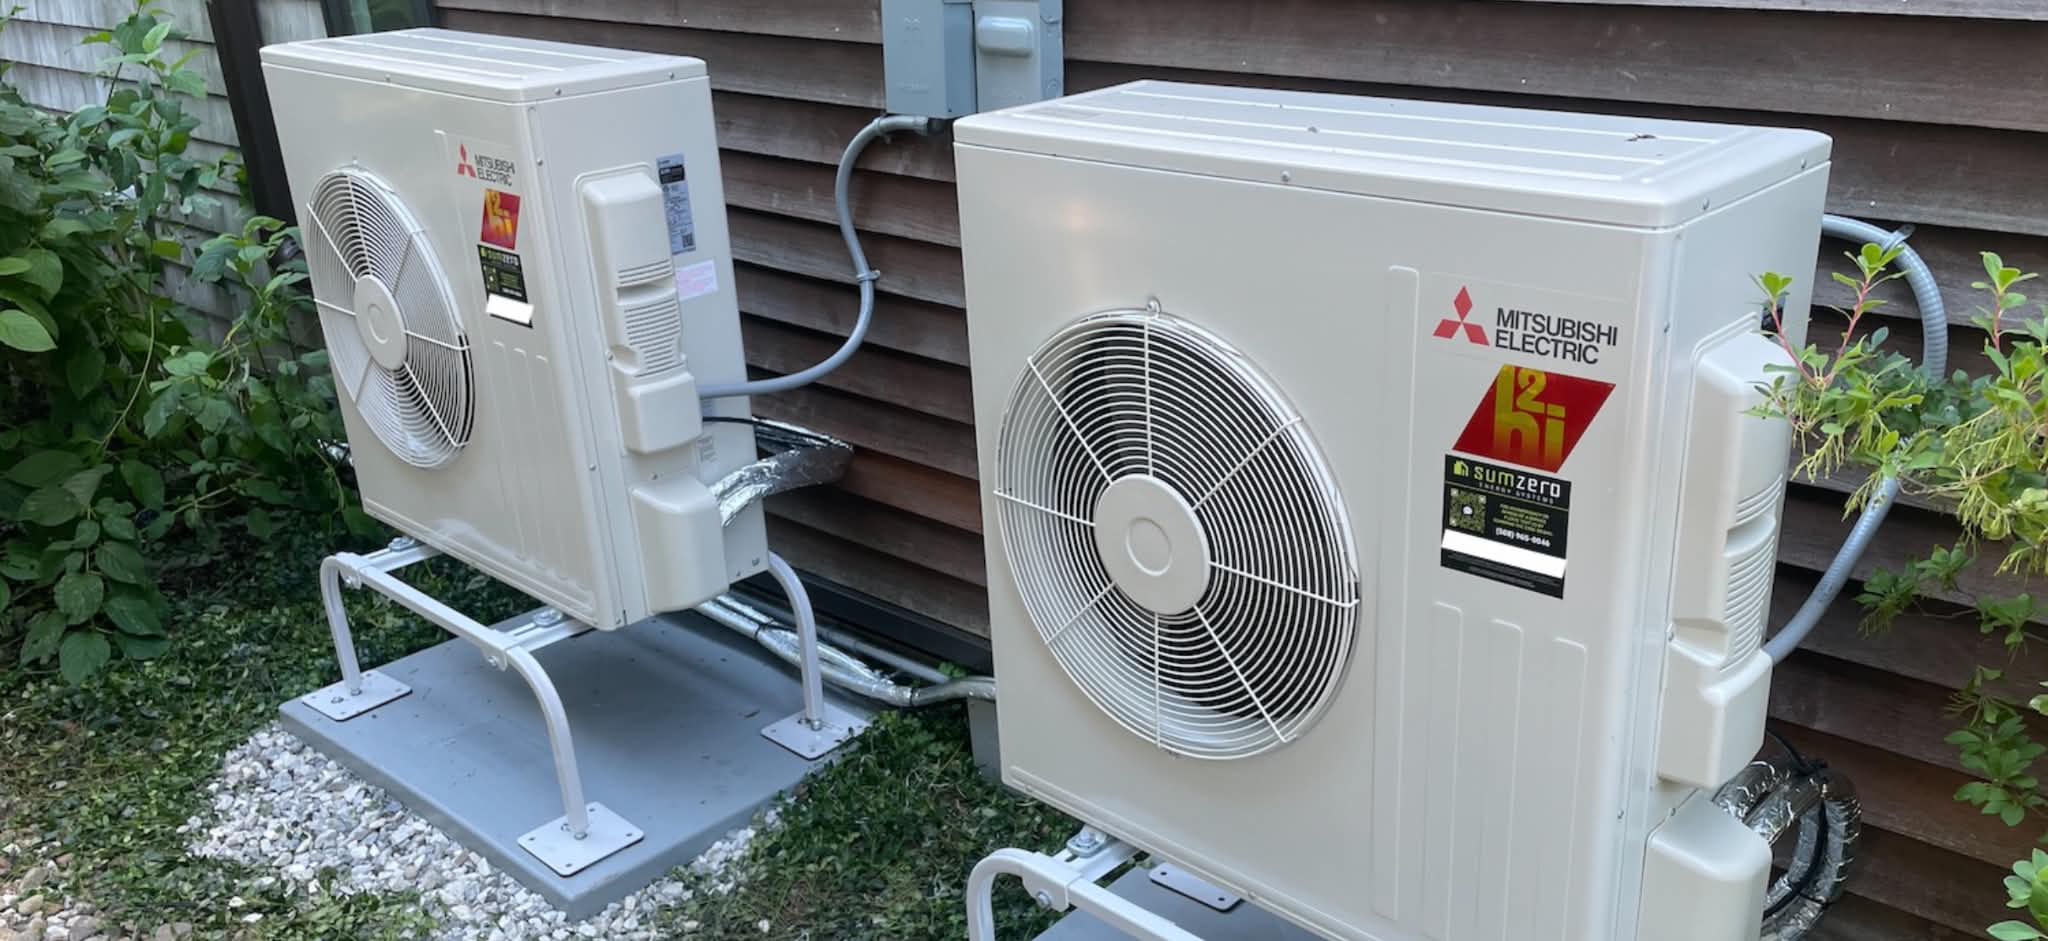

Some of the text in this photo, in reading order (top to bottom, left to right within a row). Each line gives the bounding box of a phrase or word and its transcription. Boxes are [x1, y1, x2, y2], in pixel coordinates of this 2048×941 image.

[1496, 307, 1618, 346] MITSUBISHI
[1495, 328, 1599, 364] ELECTRIC
[1473, 465, 1561, 498] sumzero
